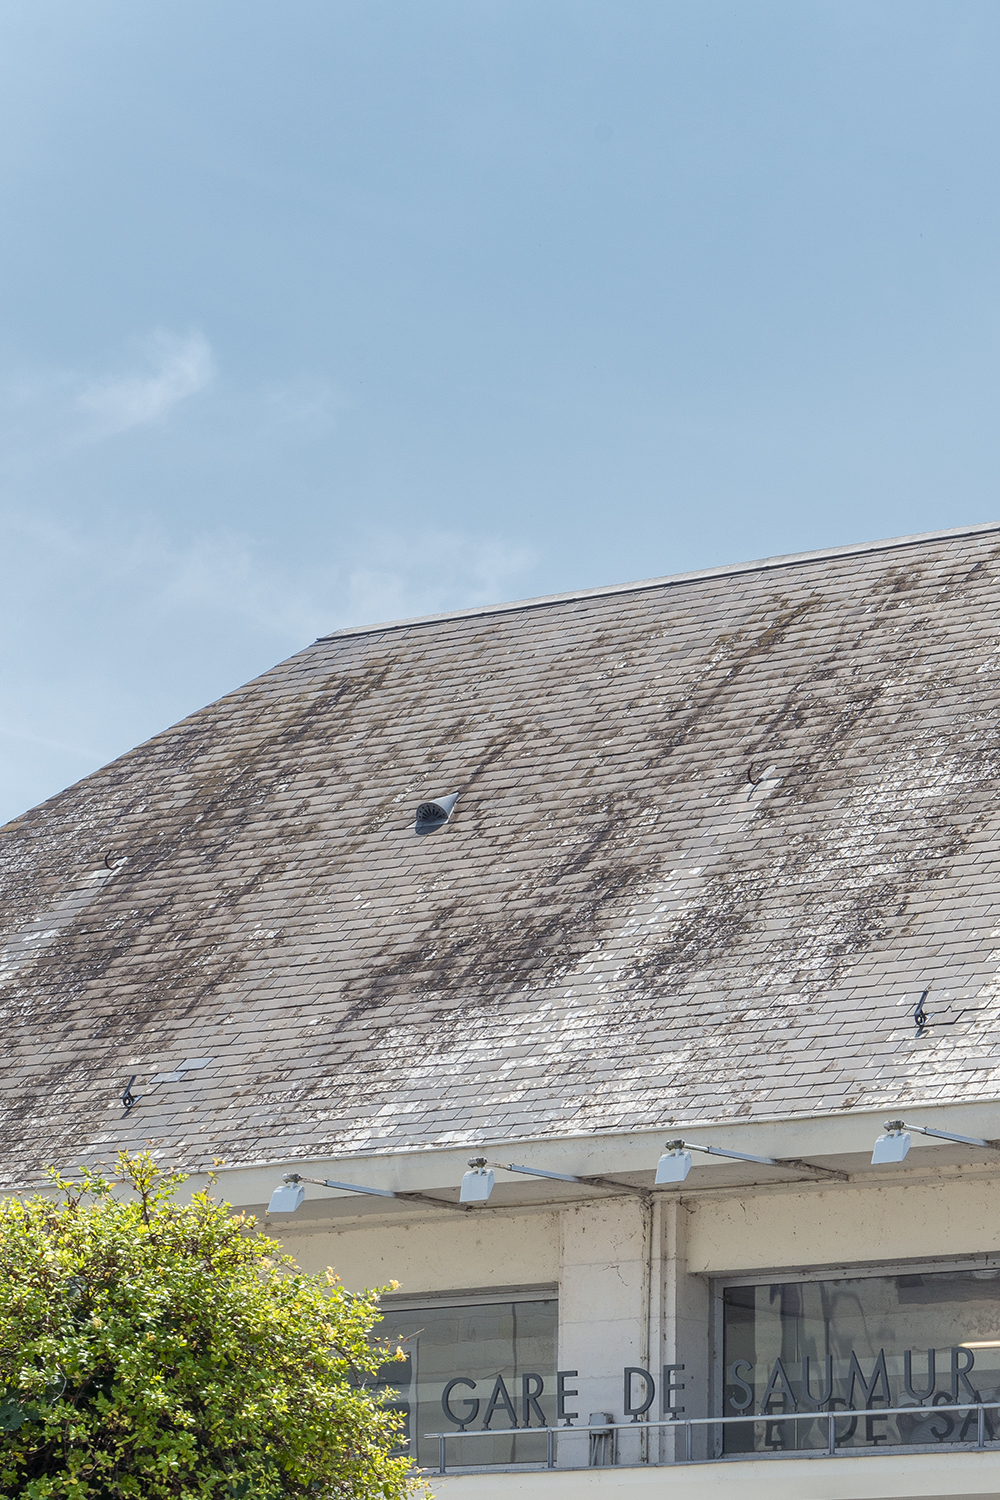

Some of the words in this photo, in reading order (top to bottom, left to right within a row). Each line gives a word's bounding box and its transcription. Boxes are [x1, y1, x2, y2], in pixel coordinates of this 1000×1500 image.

[441, 1370, 579, 1425] GARE
[623, 1363, 686, 1417] DE
[729, 1346, 979, 1411] SAUMUR
